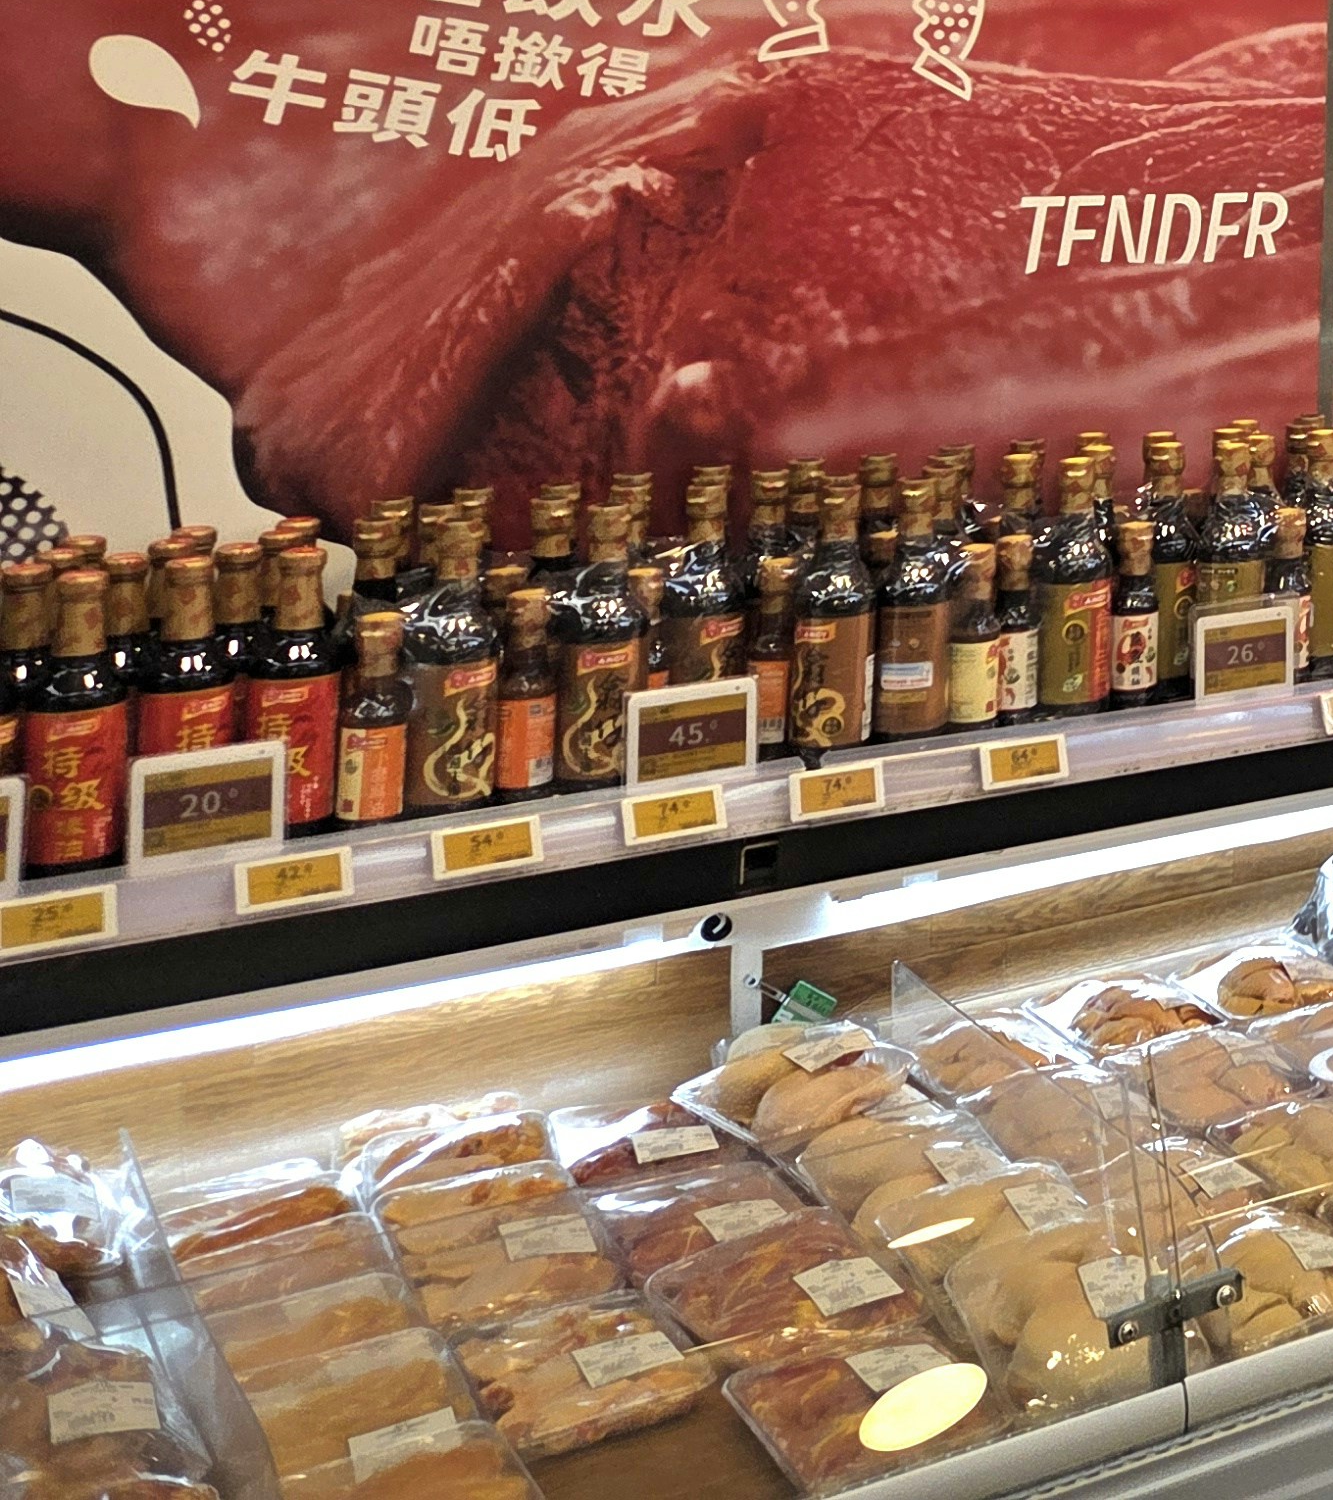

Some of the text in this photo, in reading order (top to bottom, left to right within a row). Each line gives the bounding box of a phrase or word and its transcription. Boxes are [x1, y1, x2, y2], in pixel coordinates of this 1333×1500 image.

[228, 49, 542, 162] 牛頭低
[408, 15, 651, 98] 唔撳得
